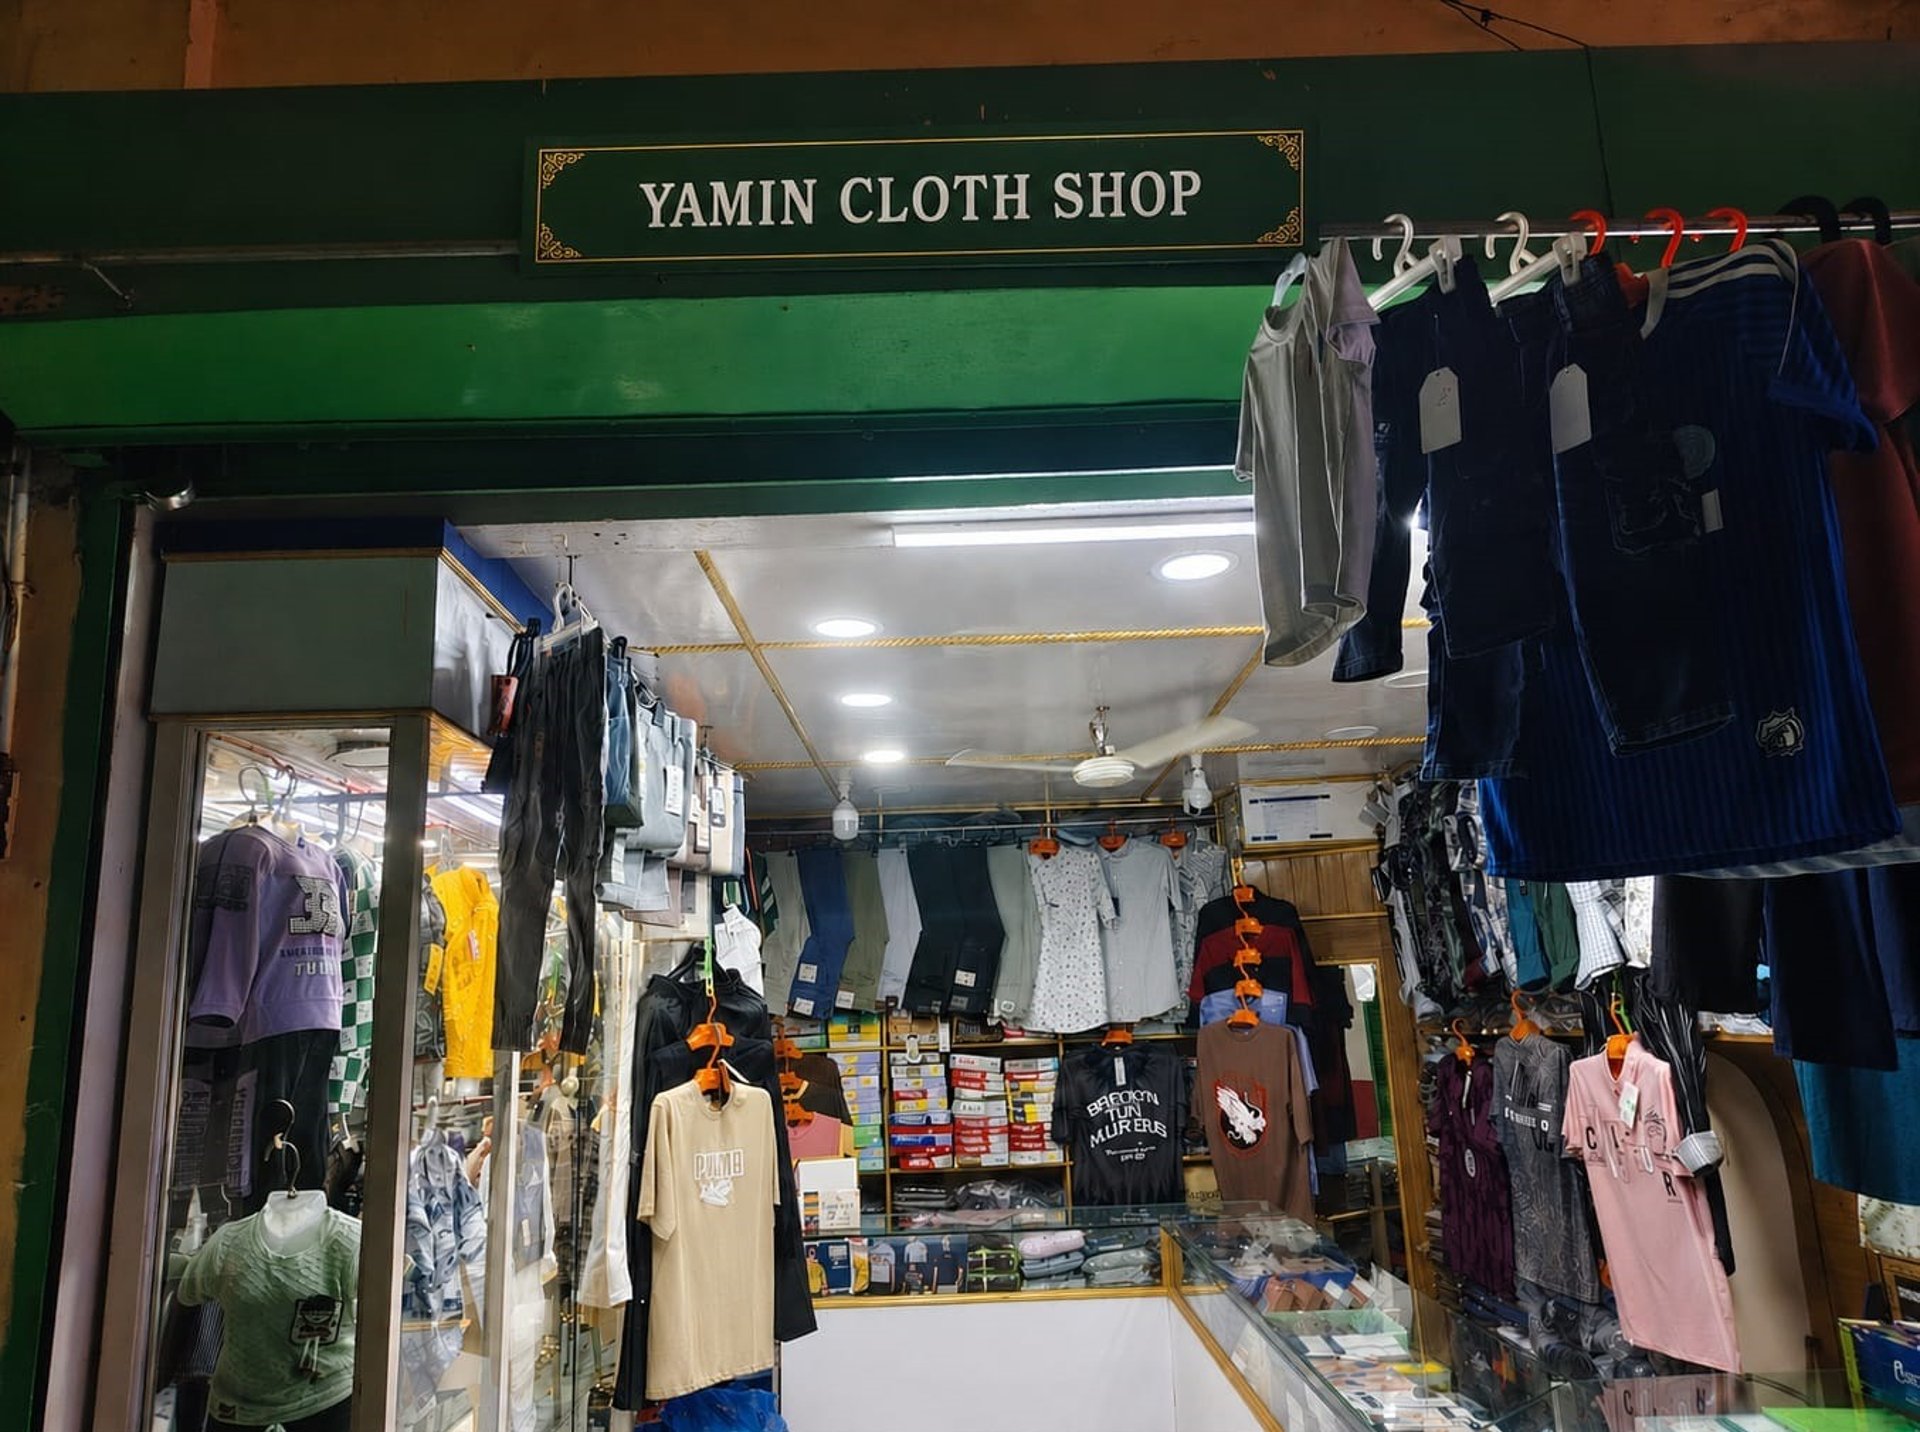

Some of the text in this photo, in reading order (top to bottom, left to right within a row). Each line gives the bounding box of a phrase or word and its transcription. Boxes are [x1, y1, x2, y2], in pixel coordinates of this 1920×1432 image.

[640, 170, 1202, 228] YAMIN CLOTH SHOP
